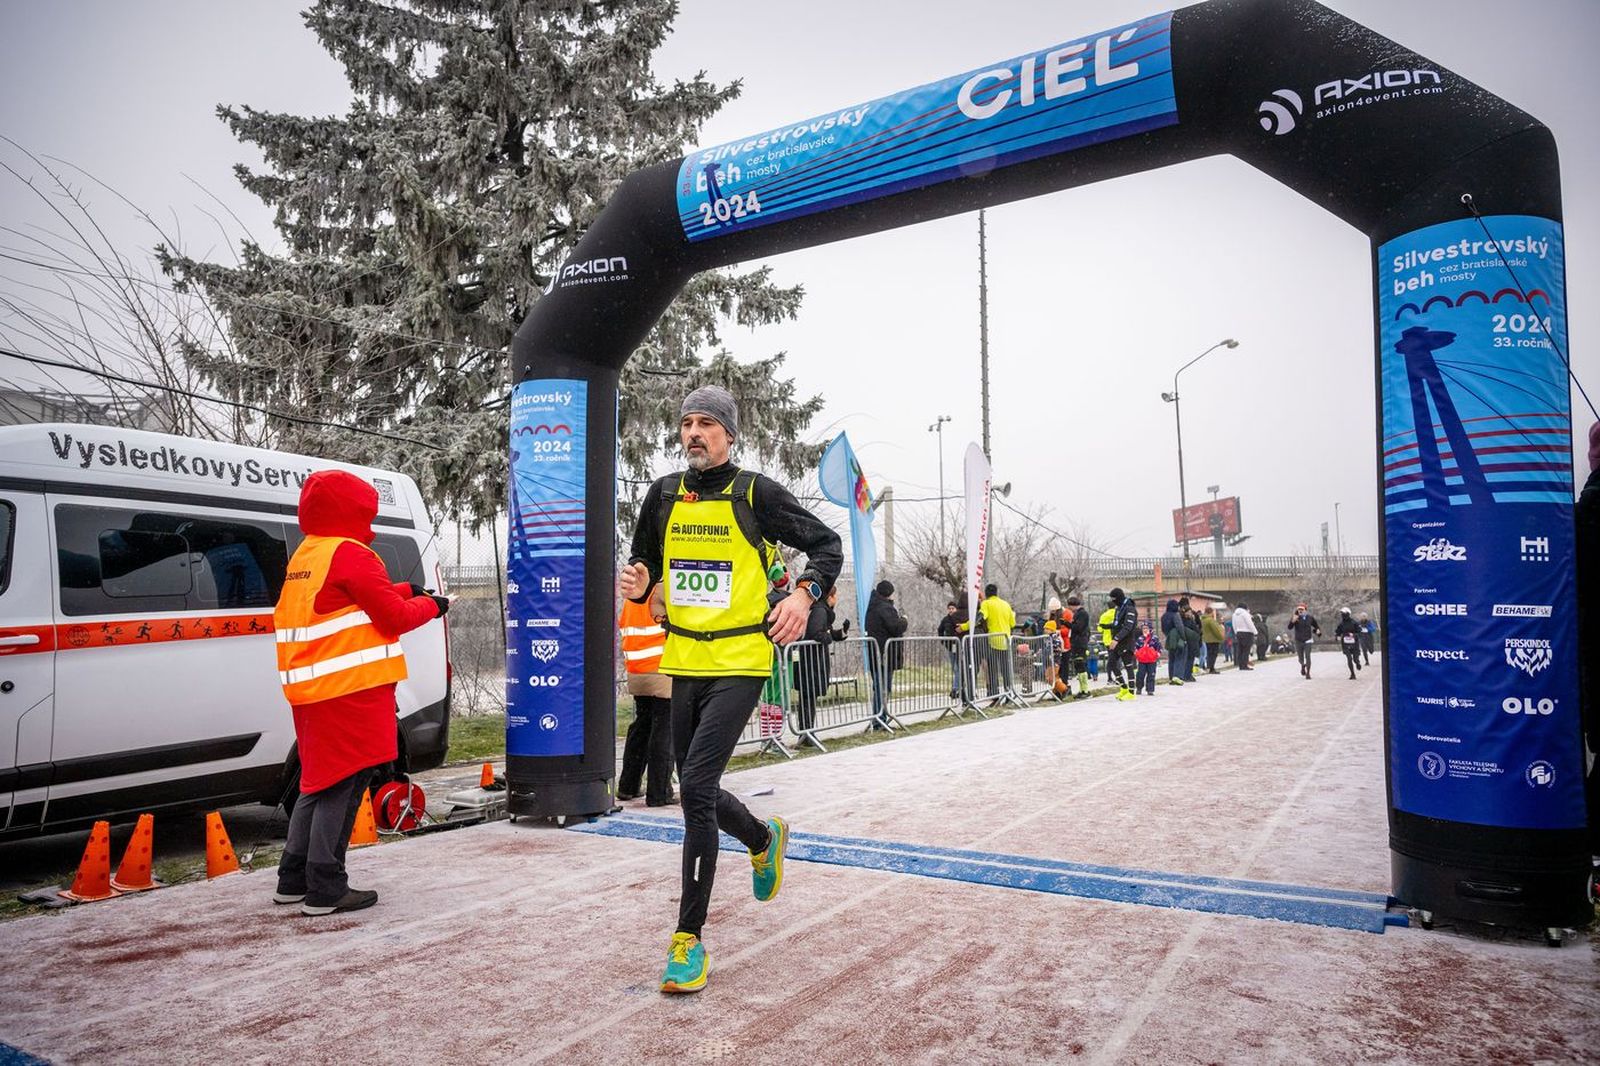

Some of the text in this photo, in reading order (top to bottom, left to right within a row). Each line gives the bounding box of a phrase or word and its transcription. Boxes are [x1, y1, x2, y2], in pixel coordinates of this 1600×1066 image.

[957, 27, 1140, 121] CIEĽ
[1314, 69, 1441, 106] AXION
[1316, 86, 1443, 119] axion4event.com
[699, 104, 871, 165] Silvestrovský
[746, 133, 835, 167] cez bratislavské
[746, 162, 782, 180] mosty
[699, 190, 761, 226] 2024
[1393, 235, 1549, 274] Silvestrovský
[562, 256, 627, 280] AXION
[1439, 257, 1528, 275] cez bratislavské
[560, 274, 629, 288] axion4event.com
[1393, 270, 1435, 296] beh
[1439, 271, 1477, 283] mosty
[1491, 314, 1553, 334] 2024
[1493, 337, 1553, 350] 33. ročník
[533, 441, 572, 453] 2024
[670, 535, 733, 544] www.autofunia.com
[681, 524, 730, 537] AUTOFUNIA
[675, 571, 719, 593] 200
[1414, 603, 1468, 616] OSHEE
[1505, 638, 1551, 648] PERSKINDOL
[1415, 649, 1470, 662] respect.
[1416, 696, 1445, 706] TAURIS
